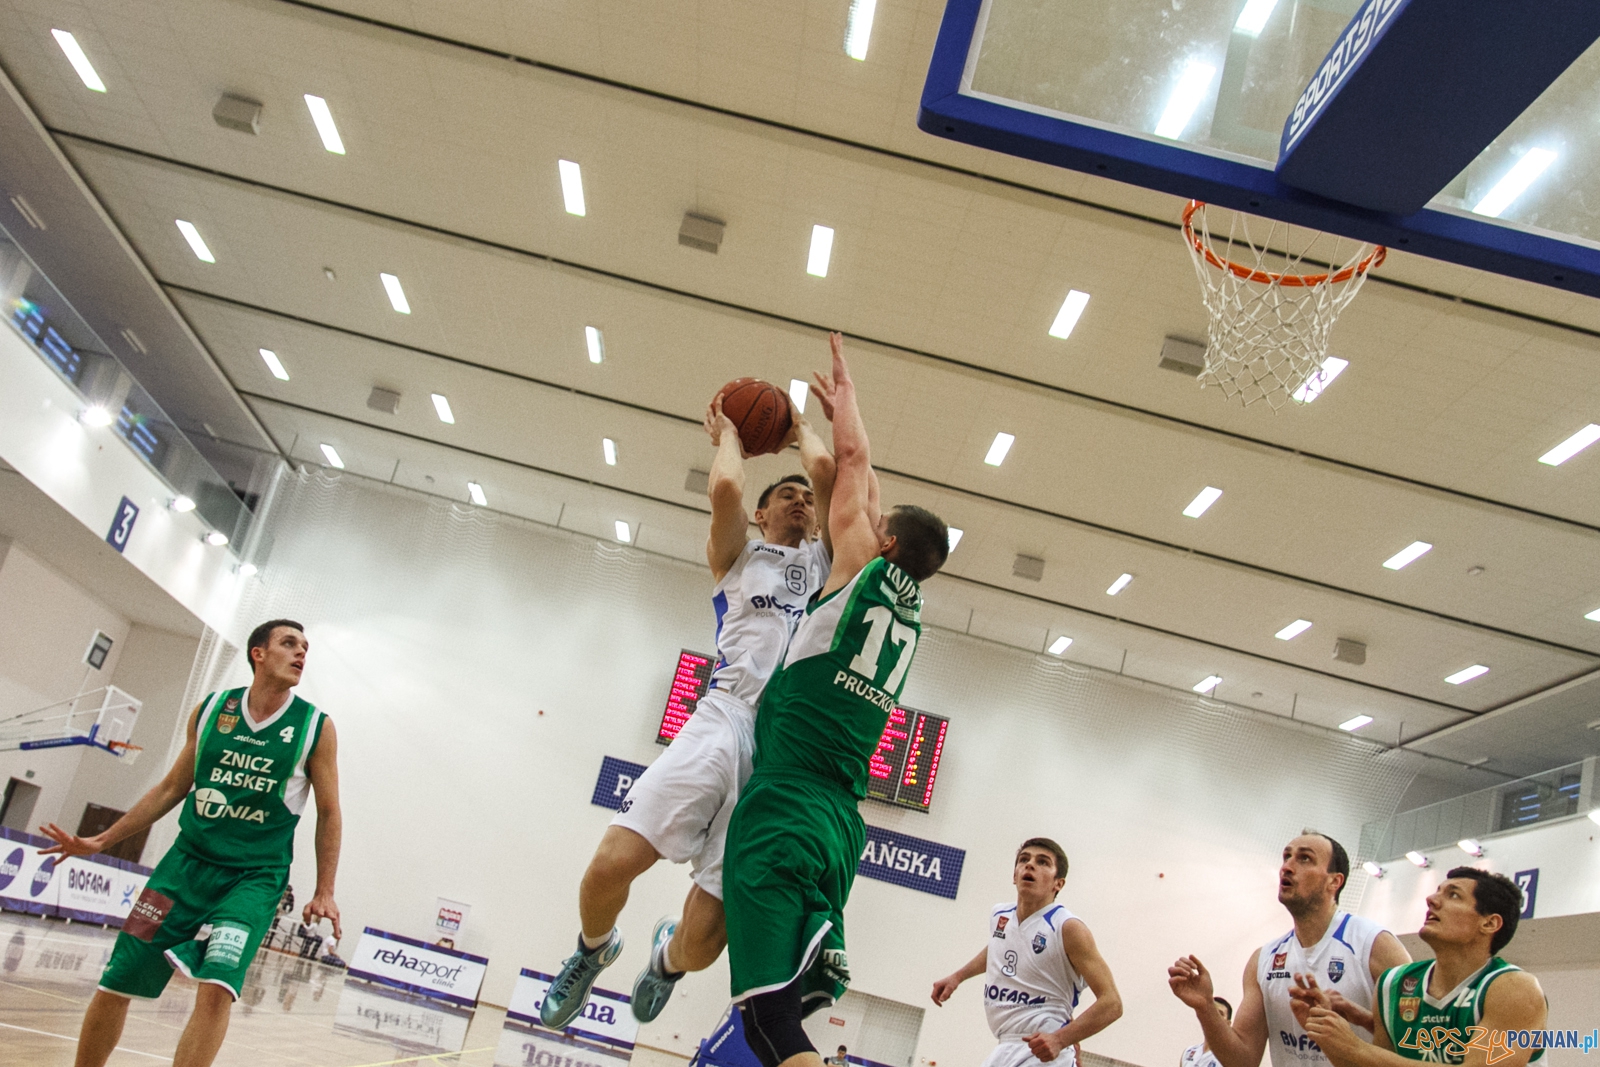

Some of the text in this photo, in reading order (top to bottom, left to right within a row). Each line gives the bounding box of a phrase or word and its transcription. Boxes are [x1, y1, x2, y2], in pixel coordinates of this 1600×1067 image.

[114, 504, 136, 545] 3
[785, 563, 807, 596] 8
[849, 605, 917, 696] 17
[833, 670, 896, 715] PRUSZKO
[279, 725, 295, 743] 4
[219, 749, 275, 774] ZNICZ
[209, 767, 278, 793] BASKET
[203, 803, 265, 824] UNIA
[68, 867, 111, 897] BIOFARM
[373, 949, 463, 982] rehasport
[1001, 949, 1018, 978] 3
[432, 977, 455, 989] clinic
